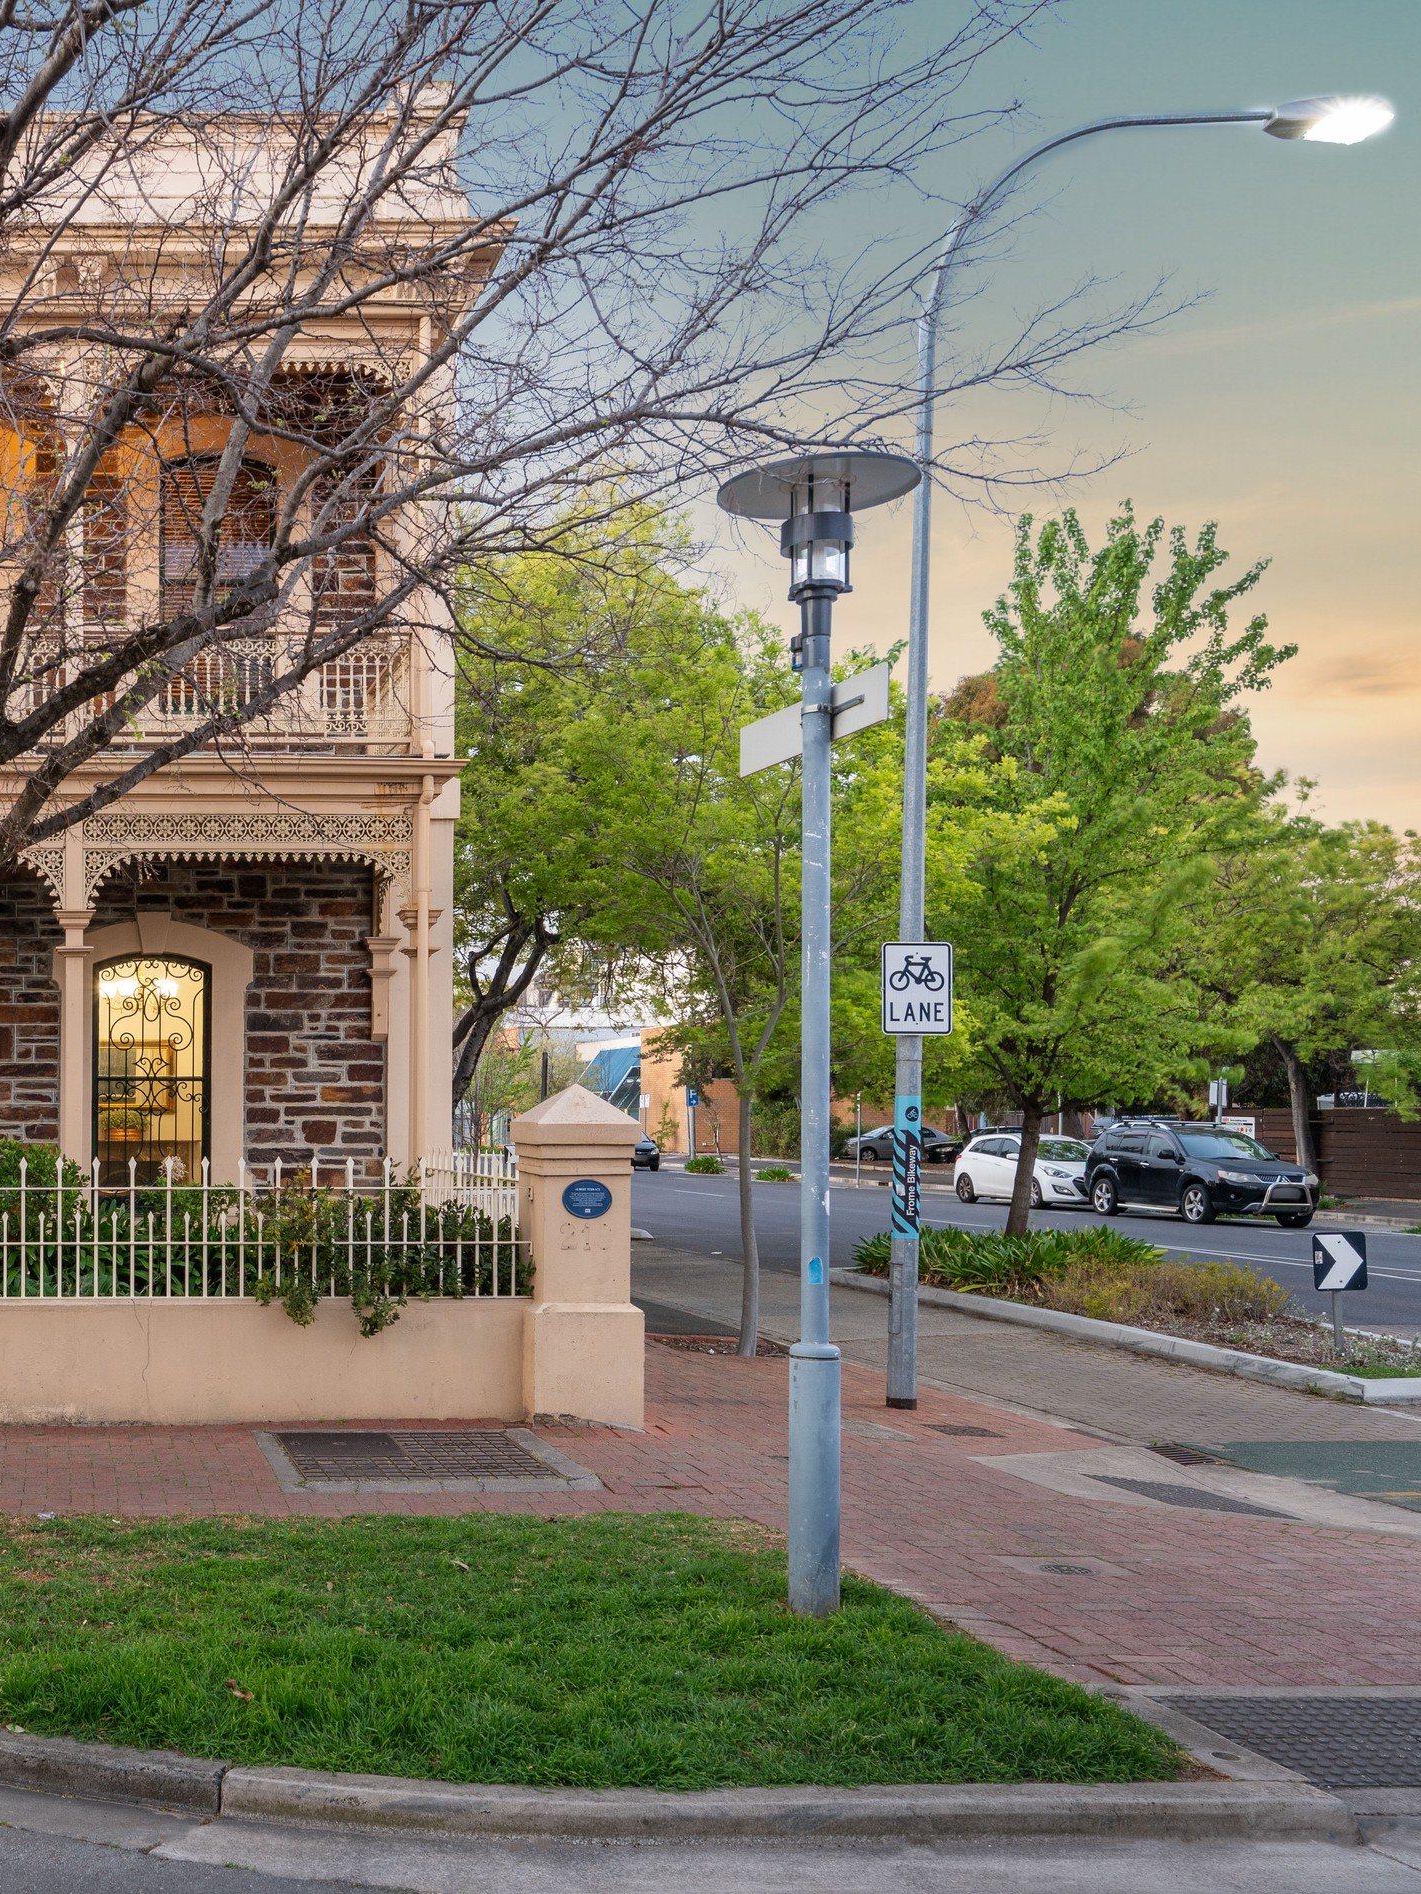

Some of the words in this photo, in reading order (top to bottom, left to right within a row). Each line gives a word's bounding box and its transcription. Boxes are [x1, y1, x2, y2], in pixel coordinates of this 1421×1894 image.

[889, 1002, 945, 1022] LANE
[906, 1144, 918, 1183] Bikeway
[906, 1187, 916, 1216] Frome
